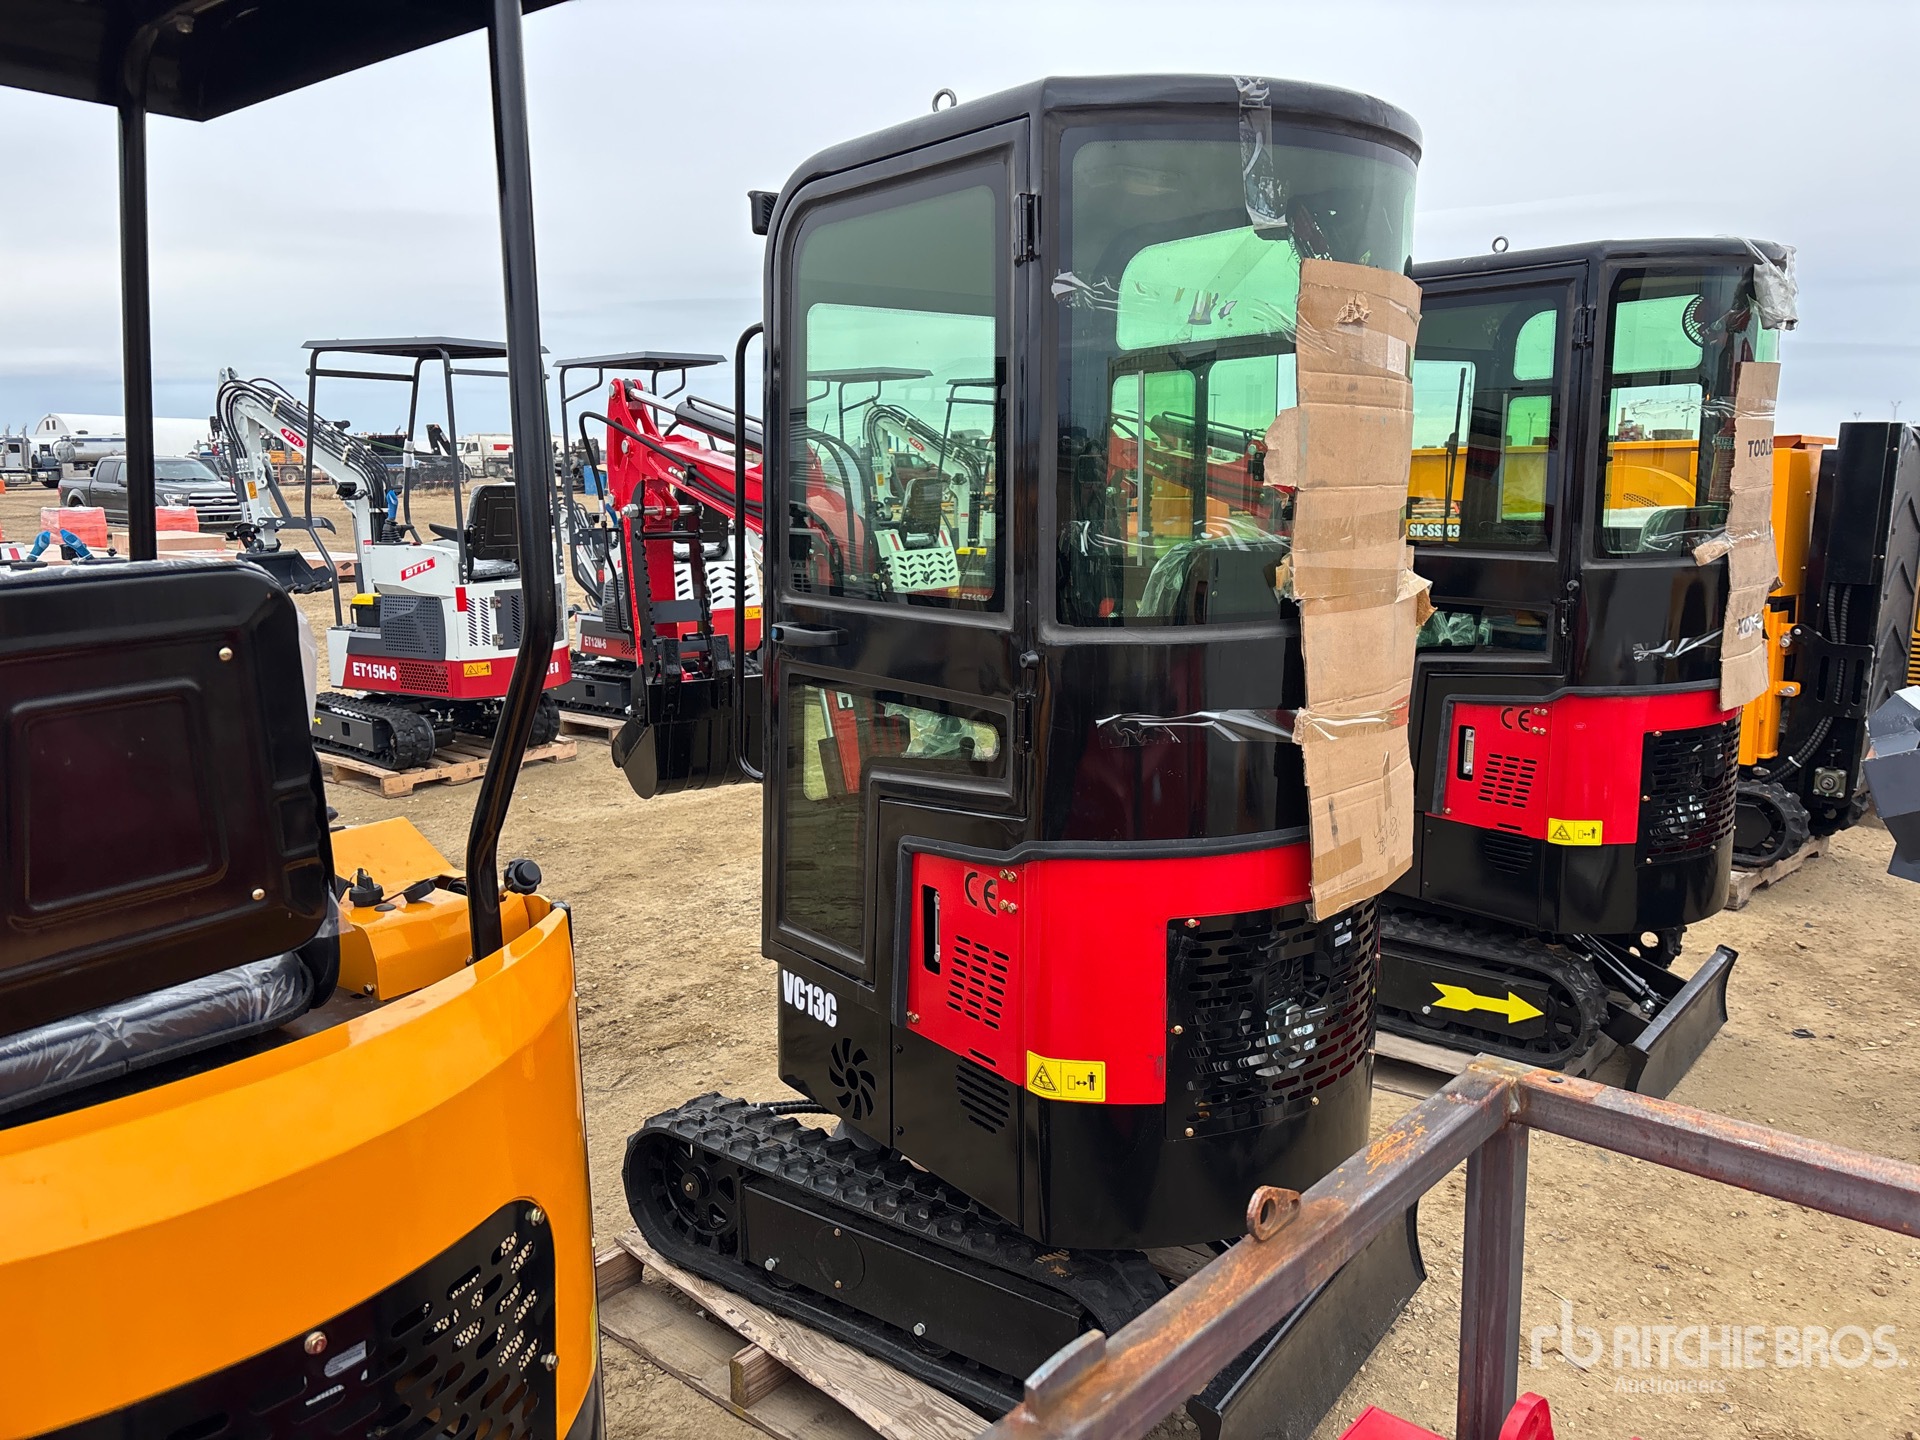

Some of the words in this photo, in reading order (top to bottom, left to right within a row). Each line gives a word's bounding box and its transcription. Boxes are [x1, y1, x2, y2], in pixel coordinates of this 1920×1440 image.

[1409, 523, 1460, 538] SK-SS43
[405, 561, 432, 578] BTTL
[352, 661, 397, 681] ET15H-6
[782, 968, 838, 1028] VC13C
